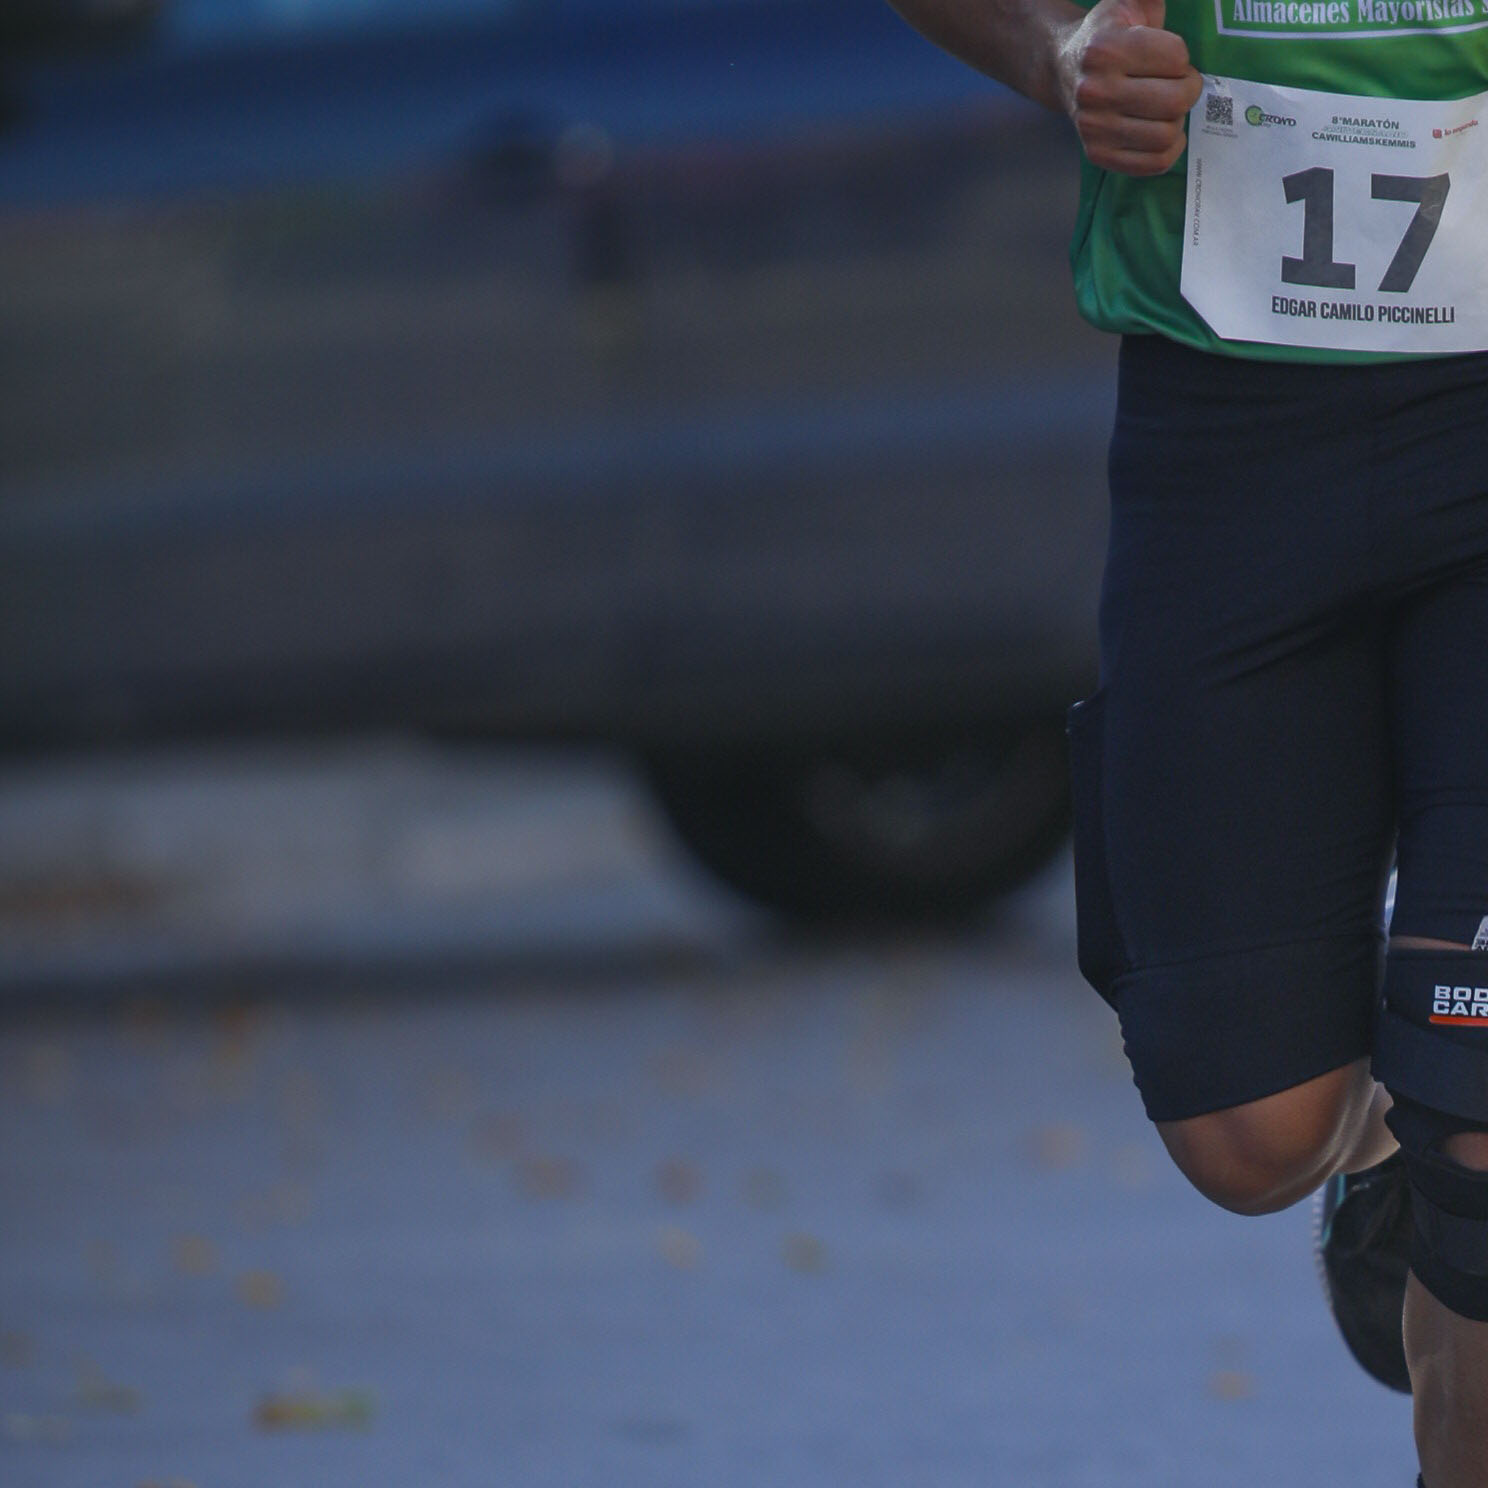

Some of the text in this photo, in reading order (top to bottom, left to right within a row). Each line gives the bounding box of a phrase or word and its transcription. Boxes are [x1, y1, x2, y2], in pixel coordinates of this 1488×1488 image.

[1311, 131, 1417, 149] CAWILLIAMSKEMMIS
[1281, 166, 1451, 293] 17
[1271, 295, 1455, 324] EDGAR CAMILO PICCINELLI
